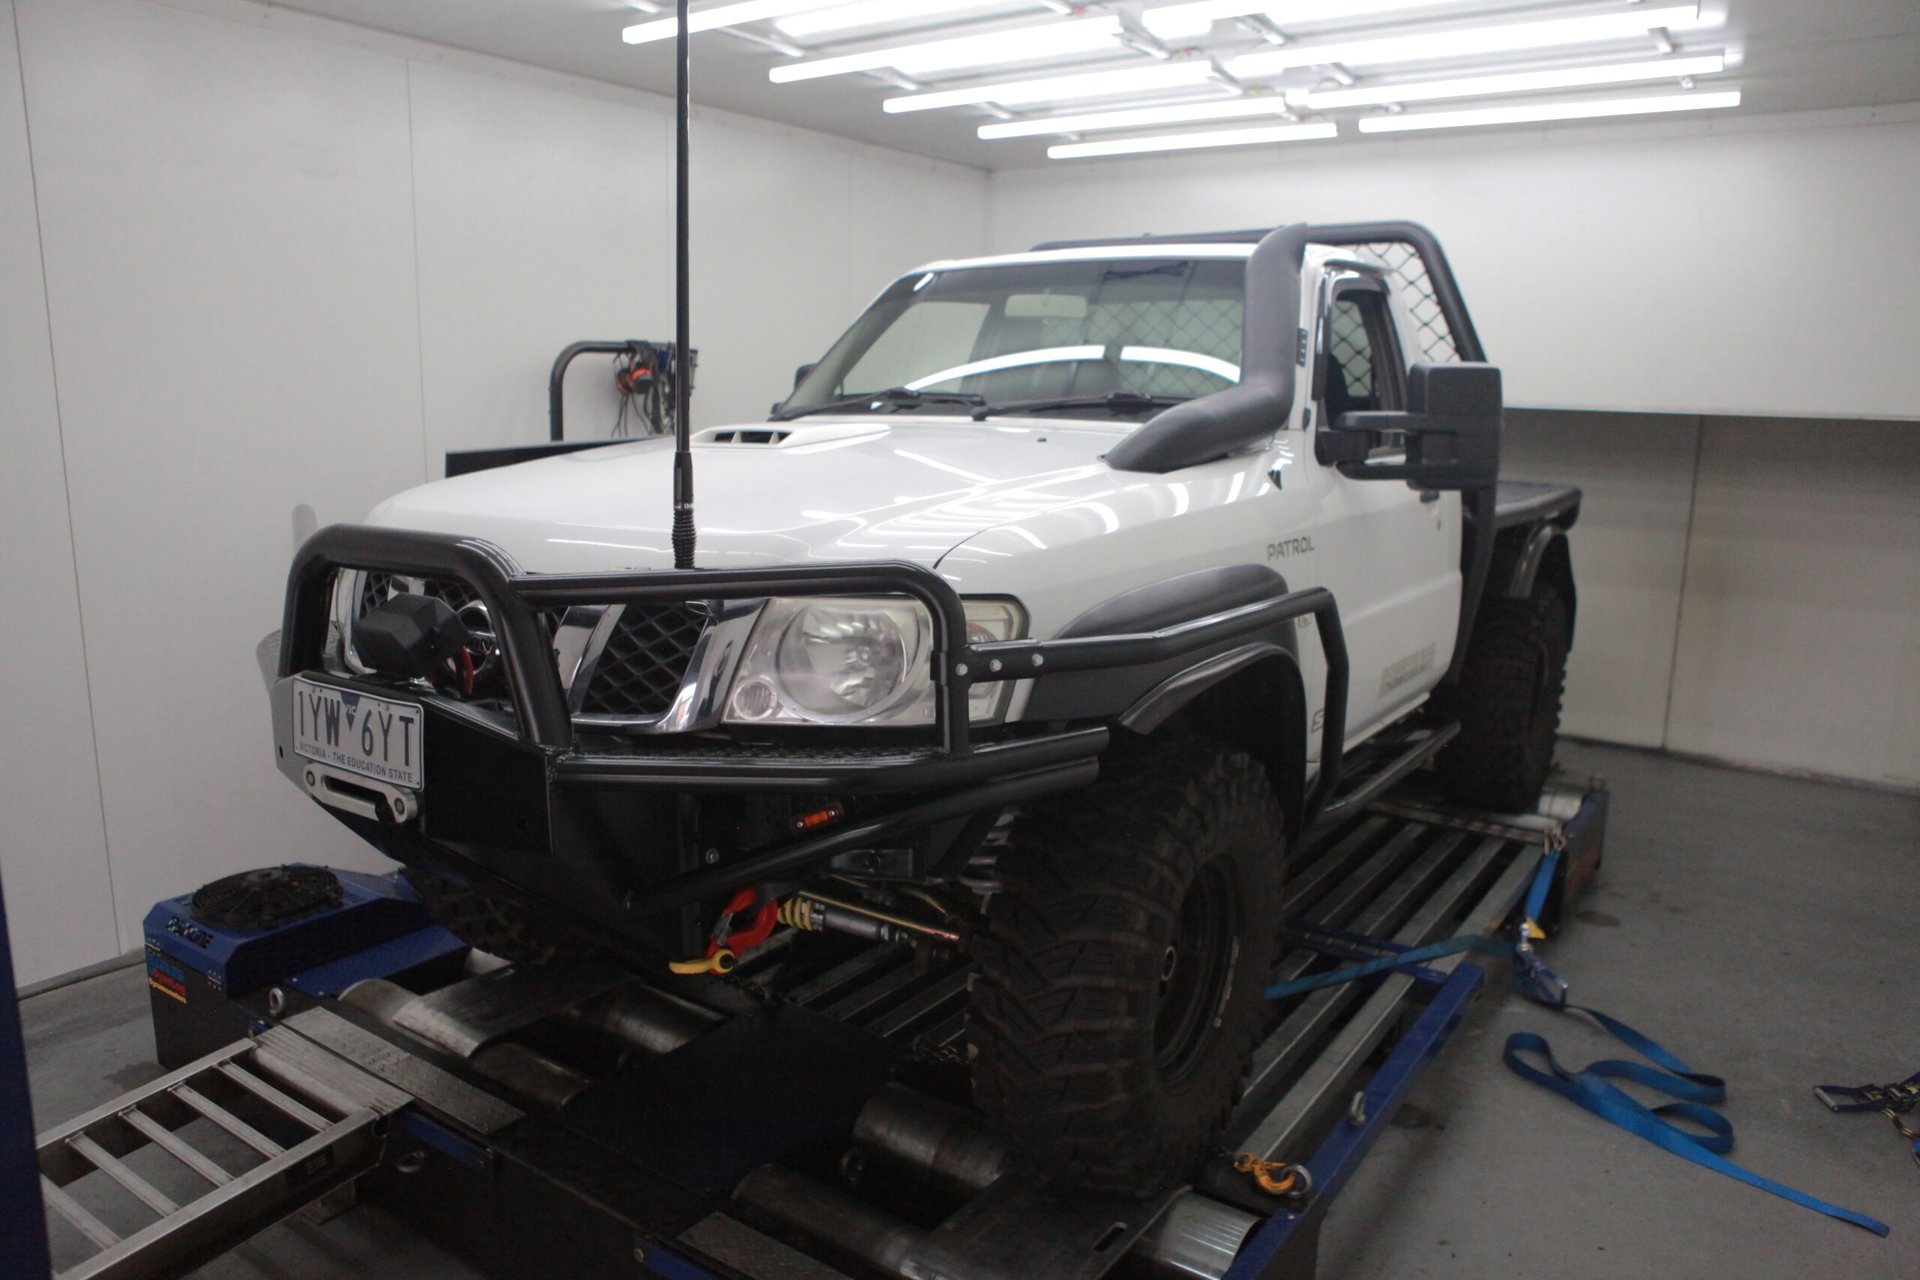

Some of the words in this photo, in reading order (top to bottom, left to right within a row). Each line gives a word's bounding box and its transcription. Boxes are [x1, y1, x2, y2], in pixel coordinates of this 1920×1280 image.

[1267, 536, 1316, 561] PATROL
[298, 691, 341, 747] 1YW
[361, 709, 414, 767] 6YT
[333, 752, 346, 763] THE
[347, 756, 386, 776] EDUCATION
[388, 768, 413, 783] STATE
